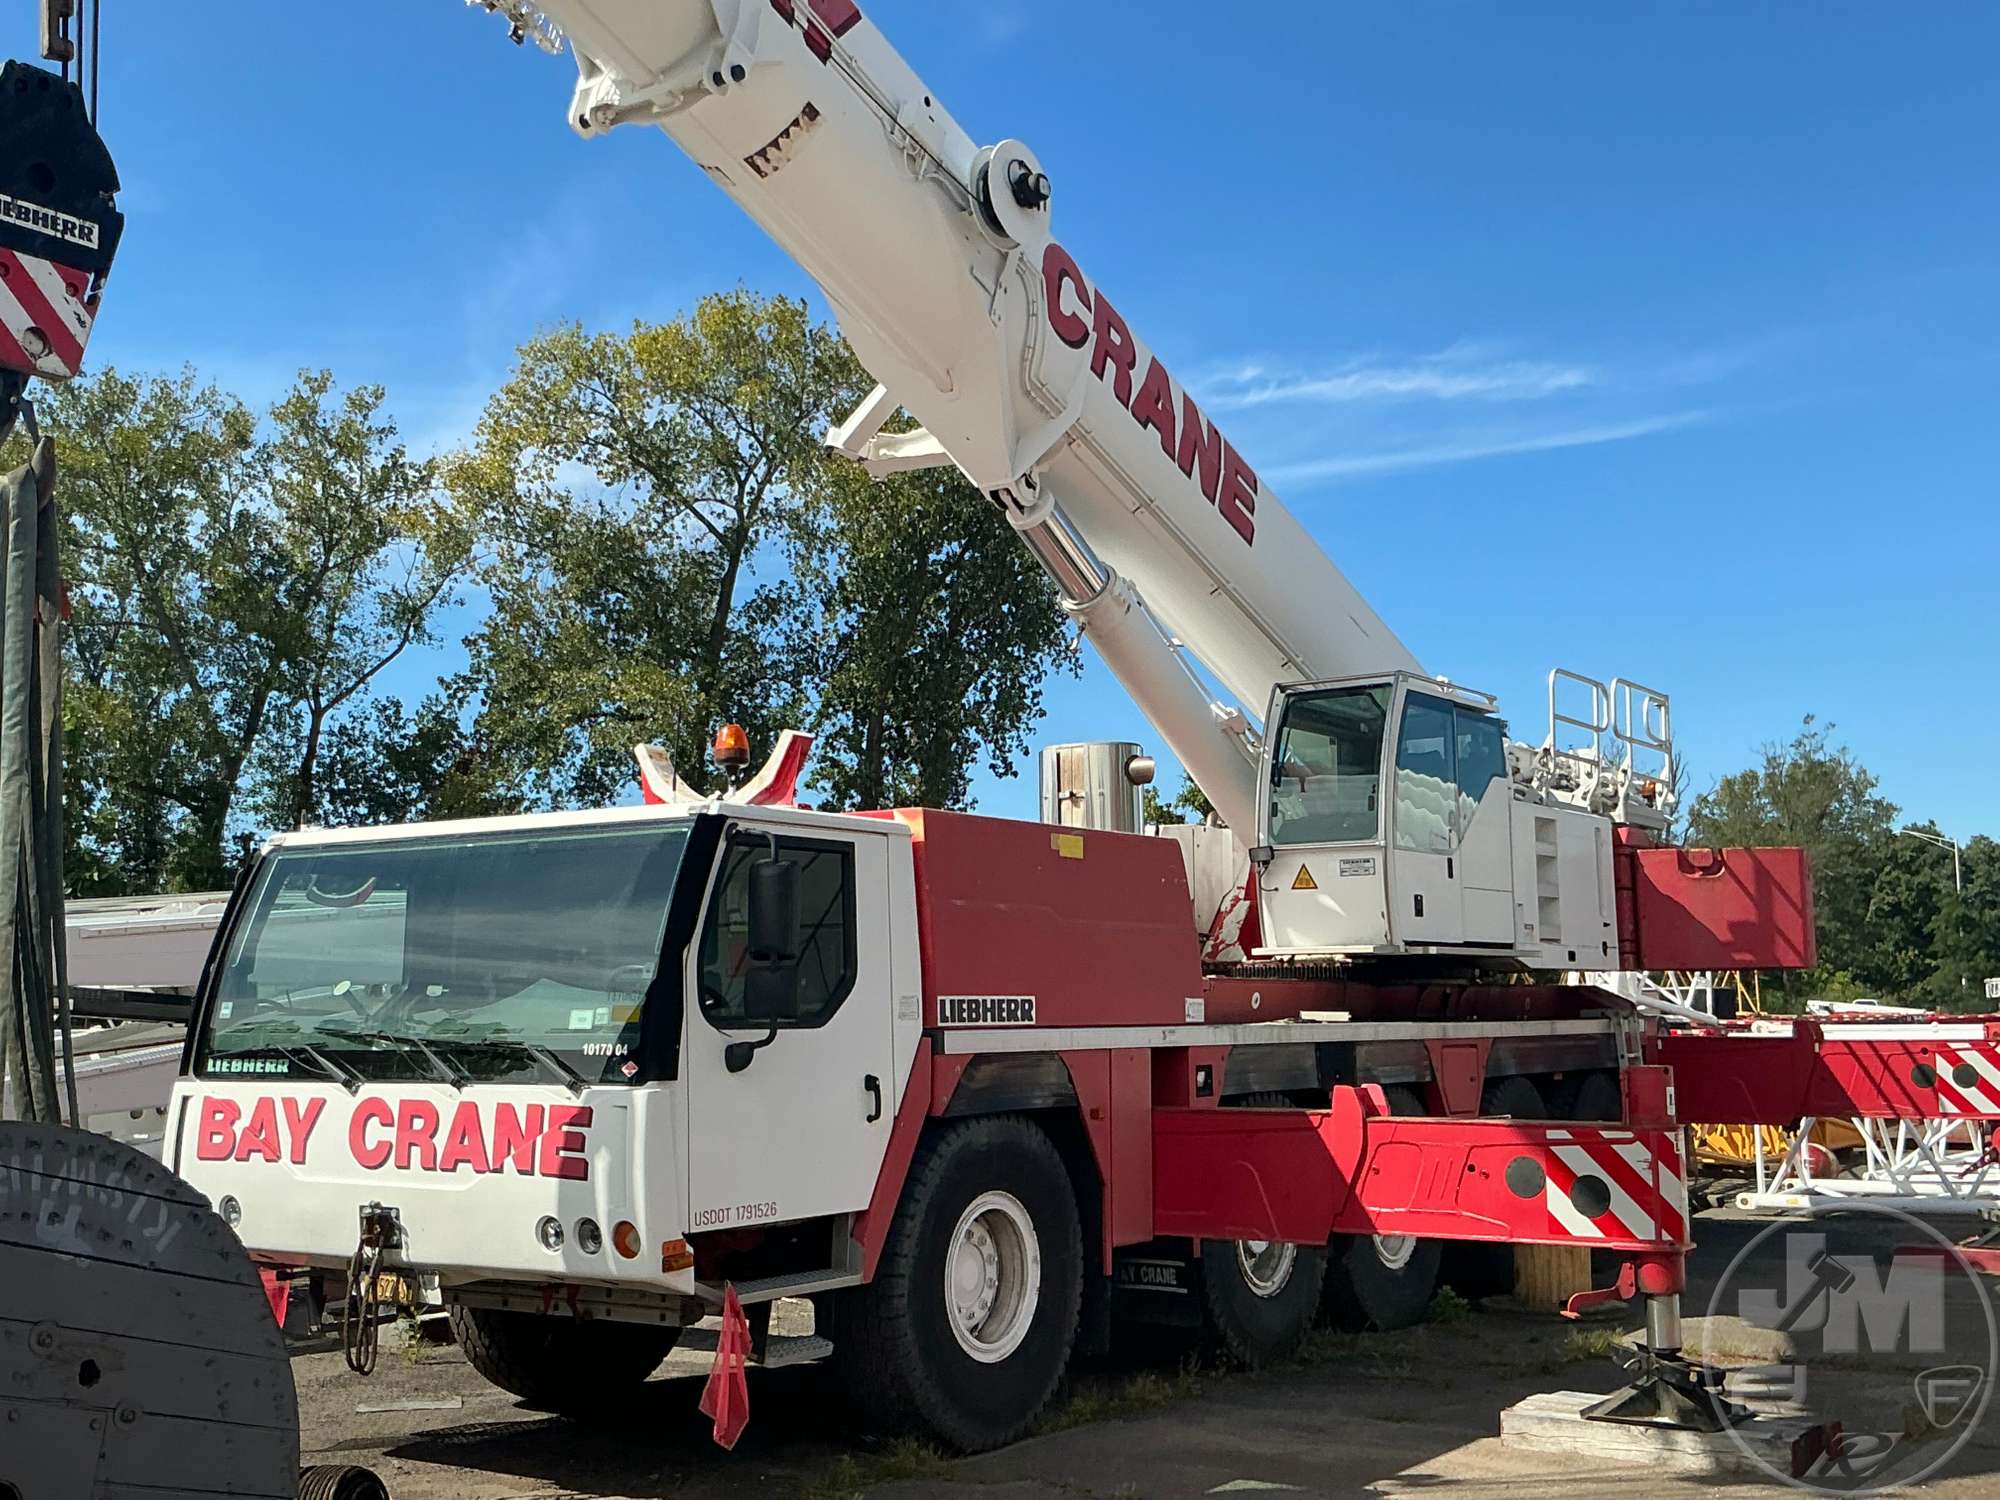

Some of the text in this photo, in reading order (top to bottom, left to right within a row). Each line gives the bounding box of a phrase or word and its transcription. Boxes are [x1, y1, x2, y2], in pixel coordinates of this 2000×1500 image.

[0, 200, 94, 242] EBHERR
[1042, 243, 1258, 547] CRANE
[939, 998, 1034, 1023] LIEBHERR
[582, 1043, 628, 1056] 10170 04
[207, 1058, 290, 1072] LIEBHERR
[197, 1096, 593, 1181] BAY CRANE
[694, 1201, 777, 1227] USDOT 1791526
[1140, 1265, 1177, 1285] CRANE
